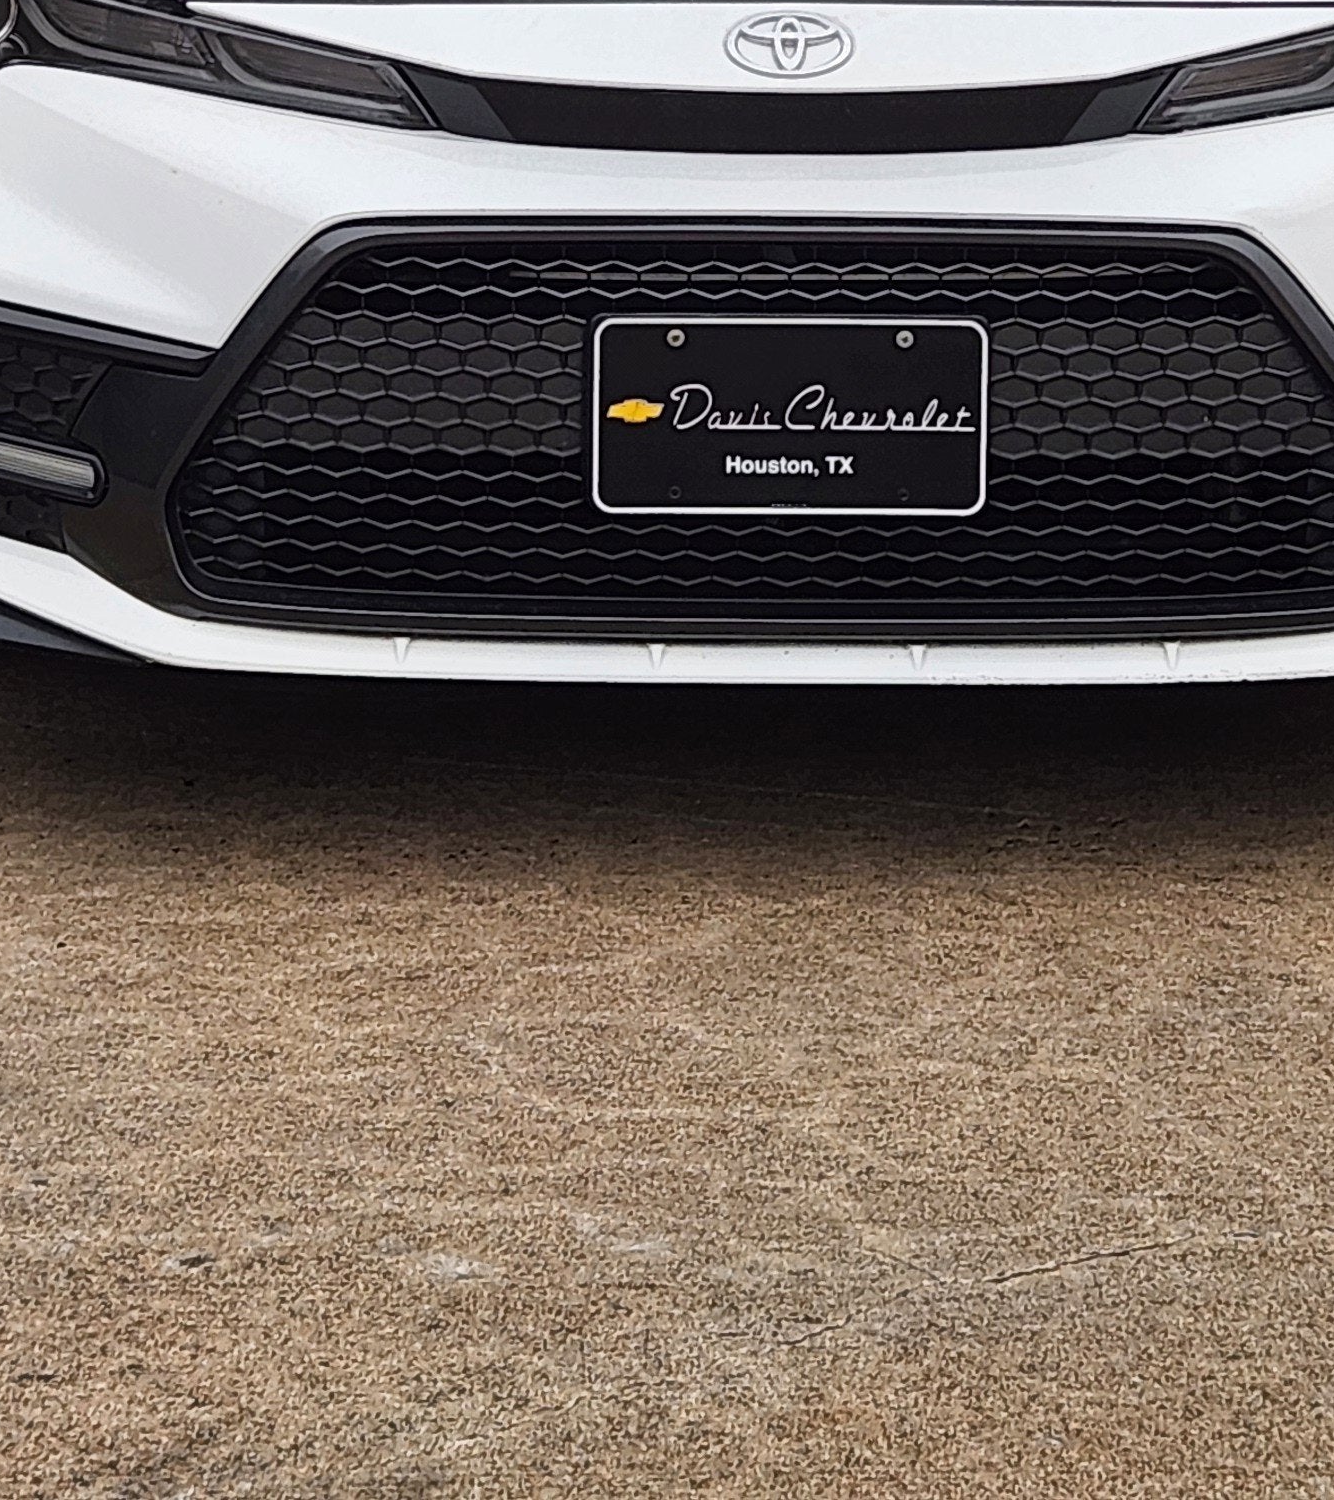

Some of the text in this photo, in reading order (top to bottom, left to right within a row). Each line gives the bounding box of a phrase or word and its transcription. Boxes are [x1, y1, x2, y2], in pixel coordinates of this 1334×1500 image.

[670, 383, 976, 433] Davis Chevrolet
[725, 456, 854, 477] Houston, TX
